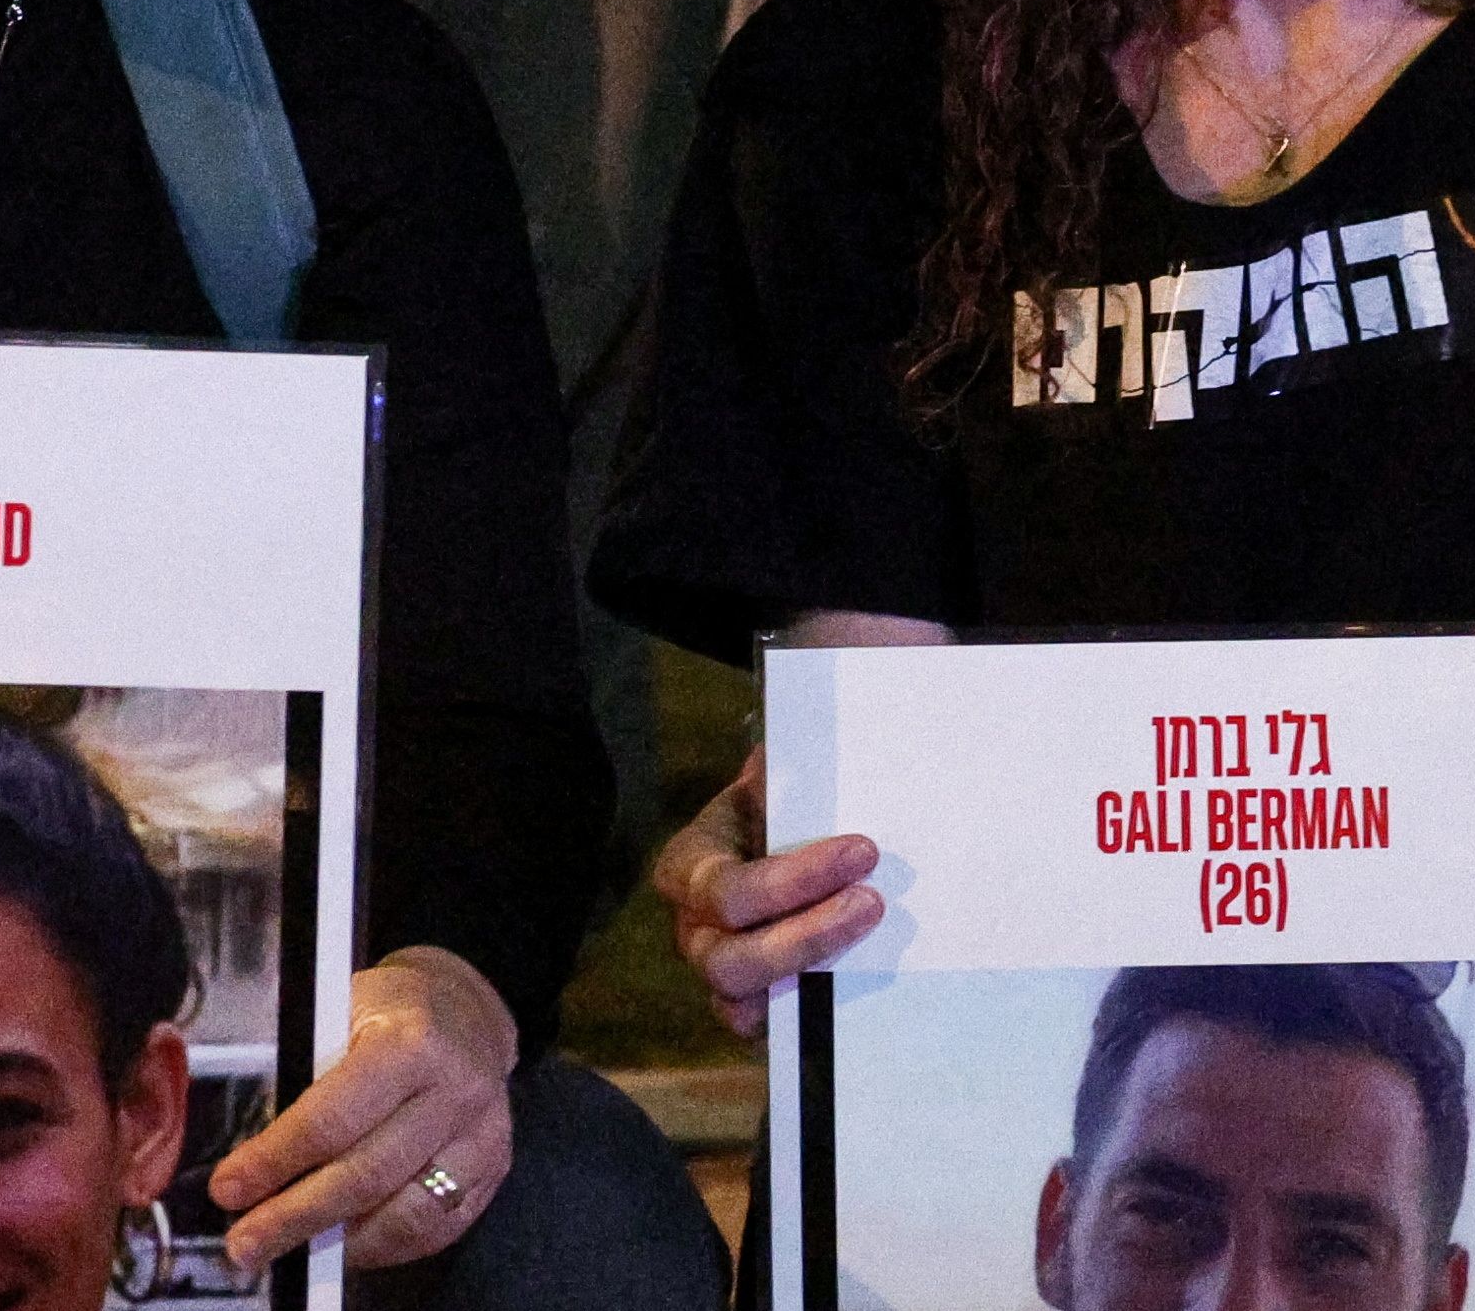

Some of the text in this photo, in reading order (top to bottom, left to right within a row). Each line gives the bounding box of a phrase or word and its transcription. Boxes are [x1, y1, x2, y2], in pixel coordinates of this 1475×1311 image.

[1152, 709, 1331, 786] גלי ברמן
[1096, 786, 1390, 854] GALI BERMAN
[1199, 857, 1289, 934] (26)
